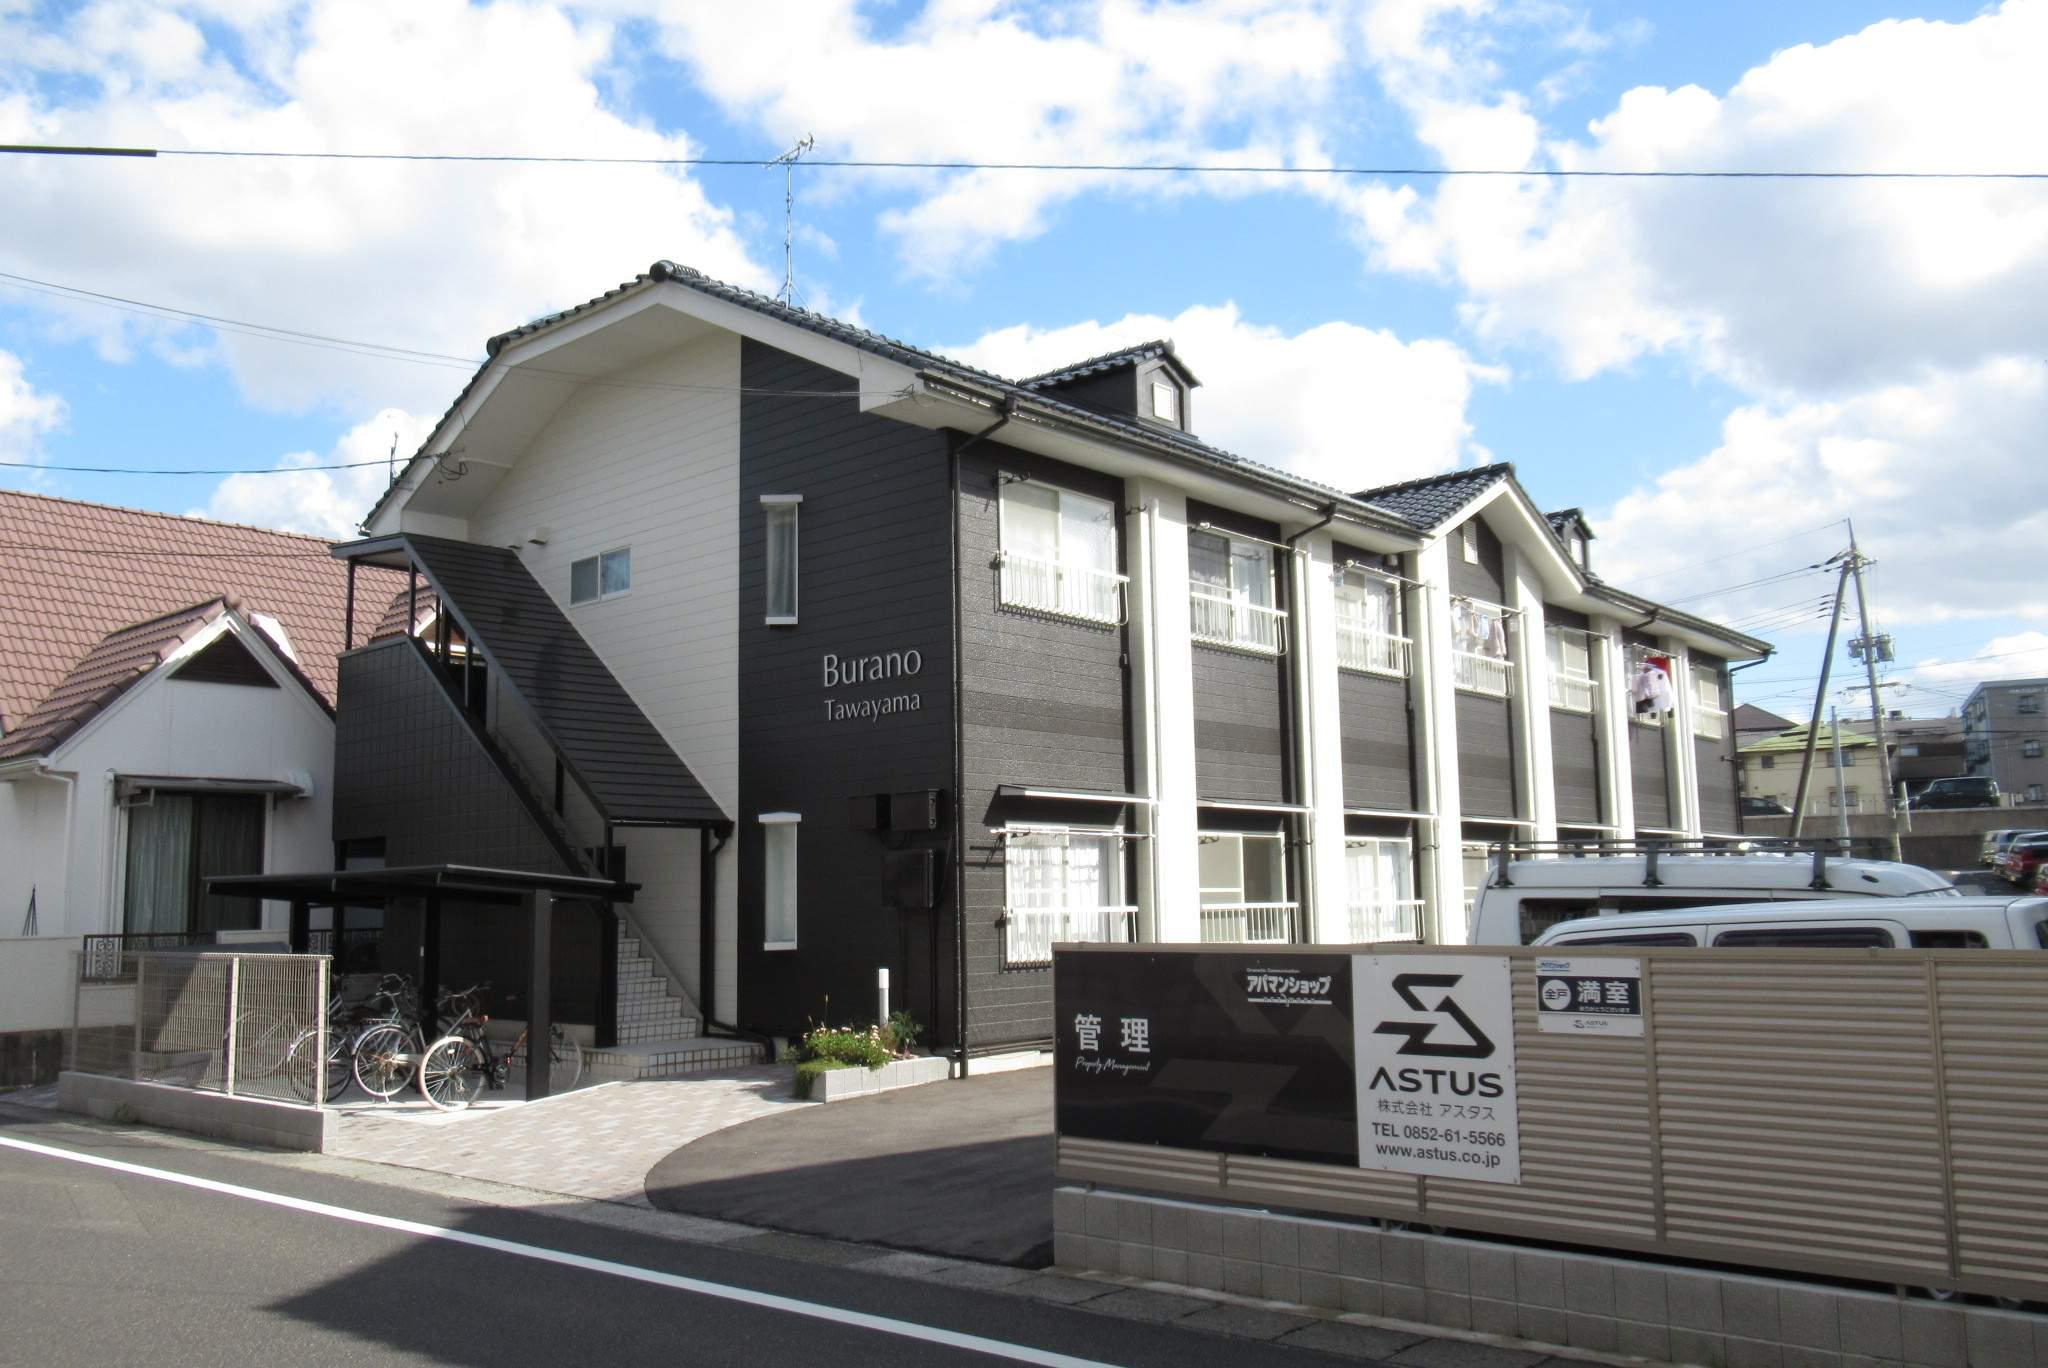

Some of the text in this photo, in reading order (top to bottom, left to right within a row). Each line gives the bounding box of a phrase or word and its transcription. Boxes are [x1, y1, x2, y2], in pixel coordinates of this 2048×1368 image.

[823, 650, 922, 688] Burano
[824, 693, 921, 723] Tawayama
[1247, 974, 1332, 994] アパマンショップ
[1544, 980, 1630, 1004] 全戸 満室
[1369, 1066, 1504, 1098] ASTUS
[1378, 1099, 1496, 1120] 株式会社 アスタス
[1371, 1122, 1506, 1147] TEL 0852-61-5566
[1376, 1143, 1501, 1169] www.astus.co.jp
